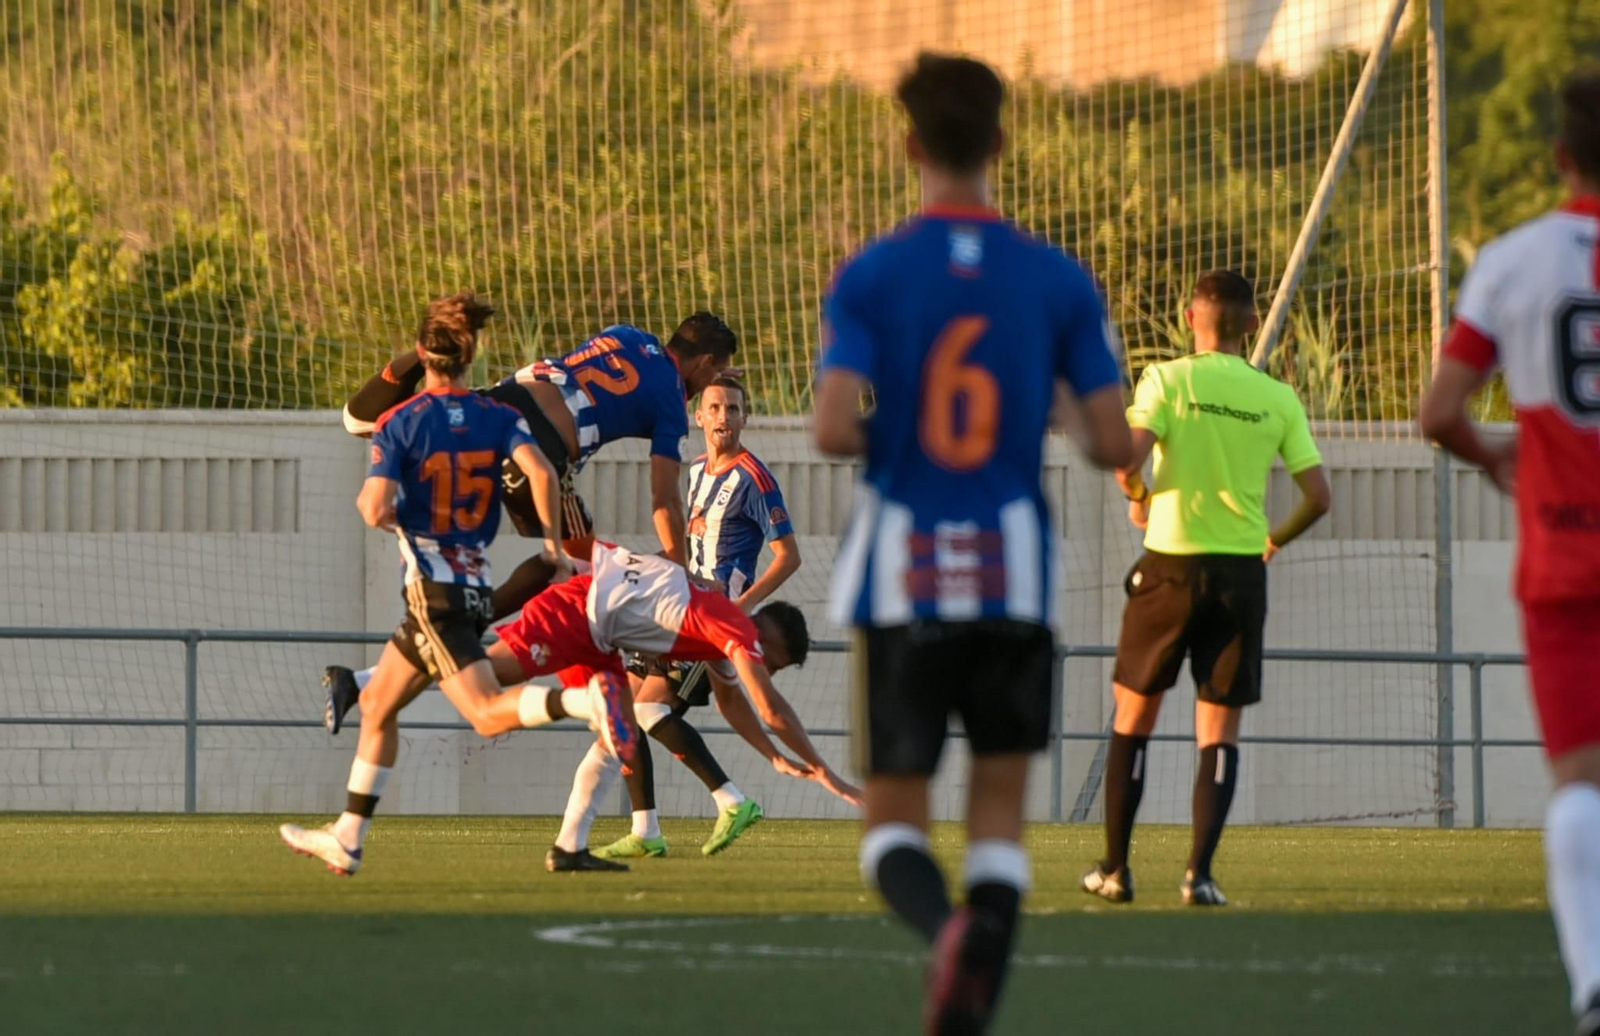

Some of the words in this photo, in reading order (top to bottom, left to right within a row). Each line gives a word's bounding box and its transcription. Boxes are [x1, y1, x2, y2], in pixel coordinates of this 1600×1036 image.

[564, 336, 640, 406] 12
[918, 315, 1001, 472] 6
[419, 450, 496, 534] 15
